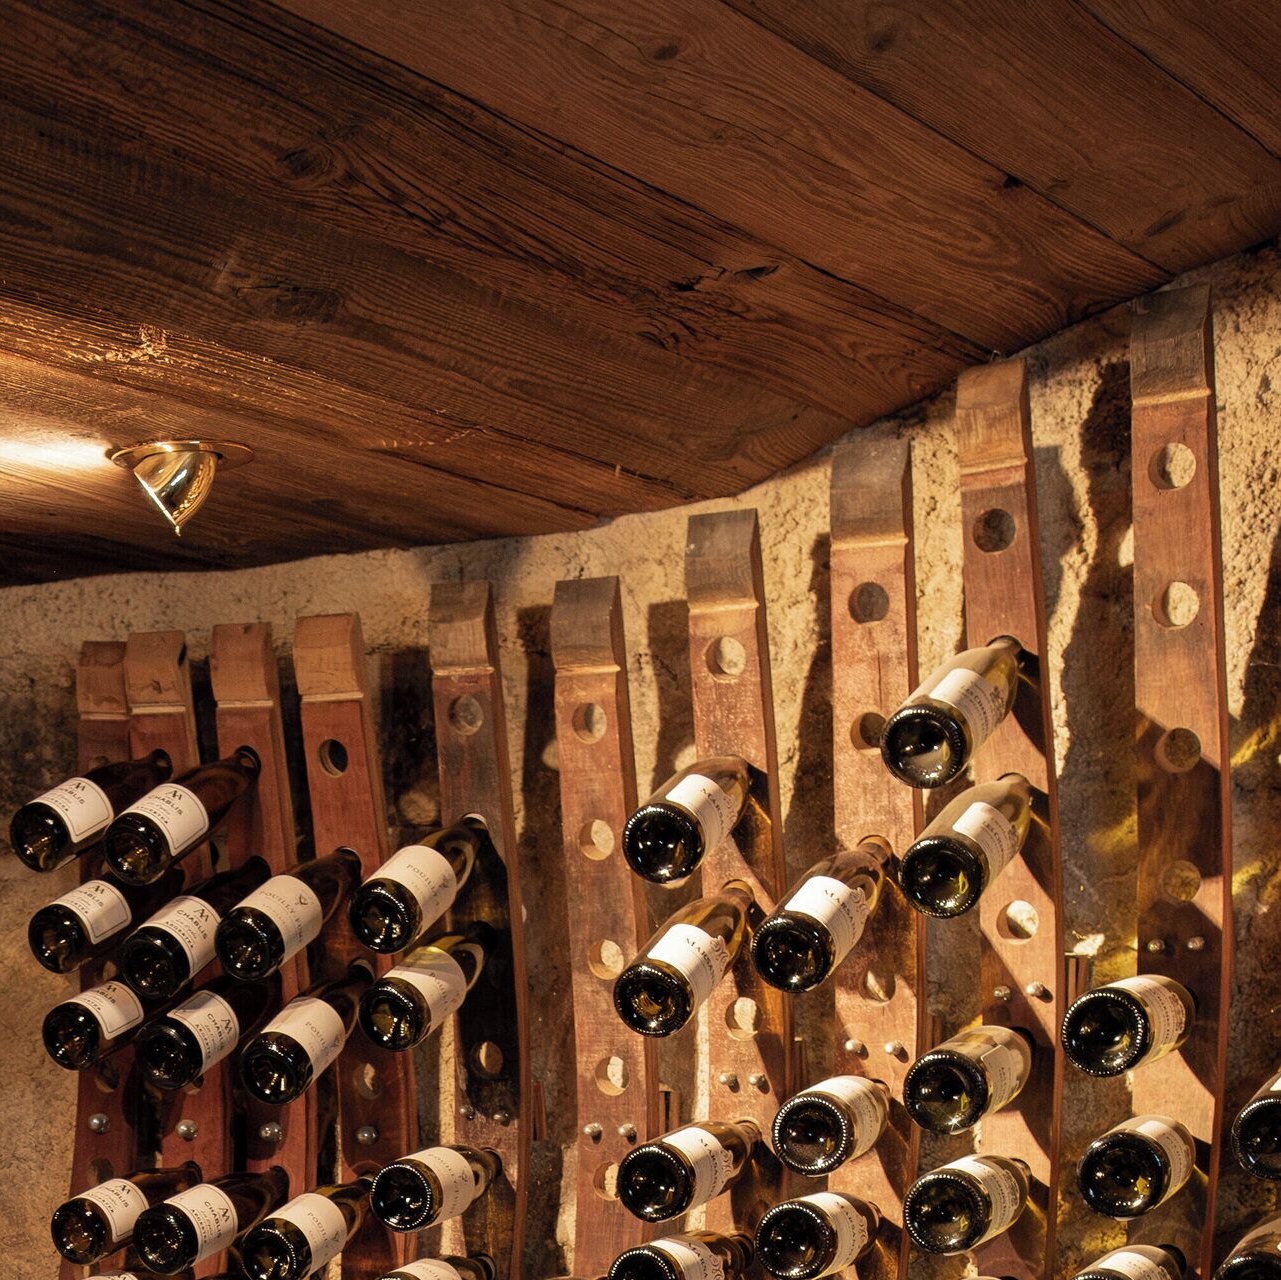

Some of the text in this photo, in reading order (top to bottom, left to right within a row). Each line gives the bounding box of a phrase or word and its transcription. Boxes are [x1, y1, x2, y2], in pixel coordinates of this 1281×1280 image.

[175, 905, 210, 942] CHABLIS
[205, 1011, 228, 1049] CHABLIS
[203, 1198, 223, 1239] CHABLIS
